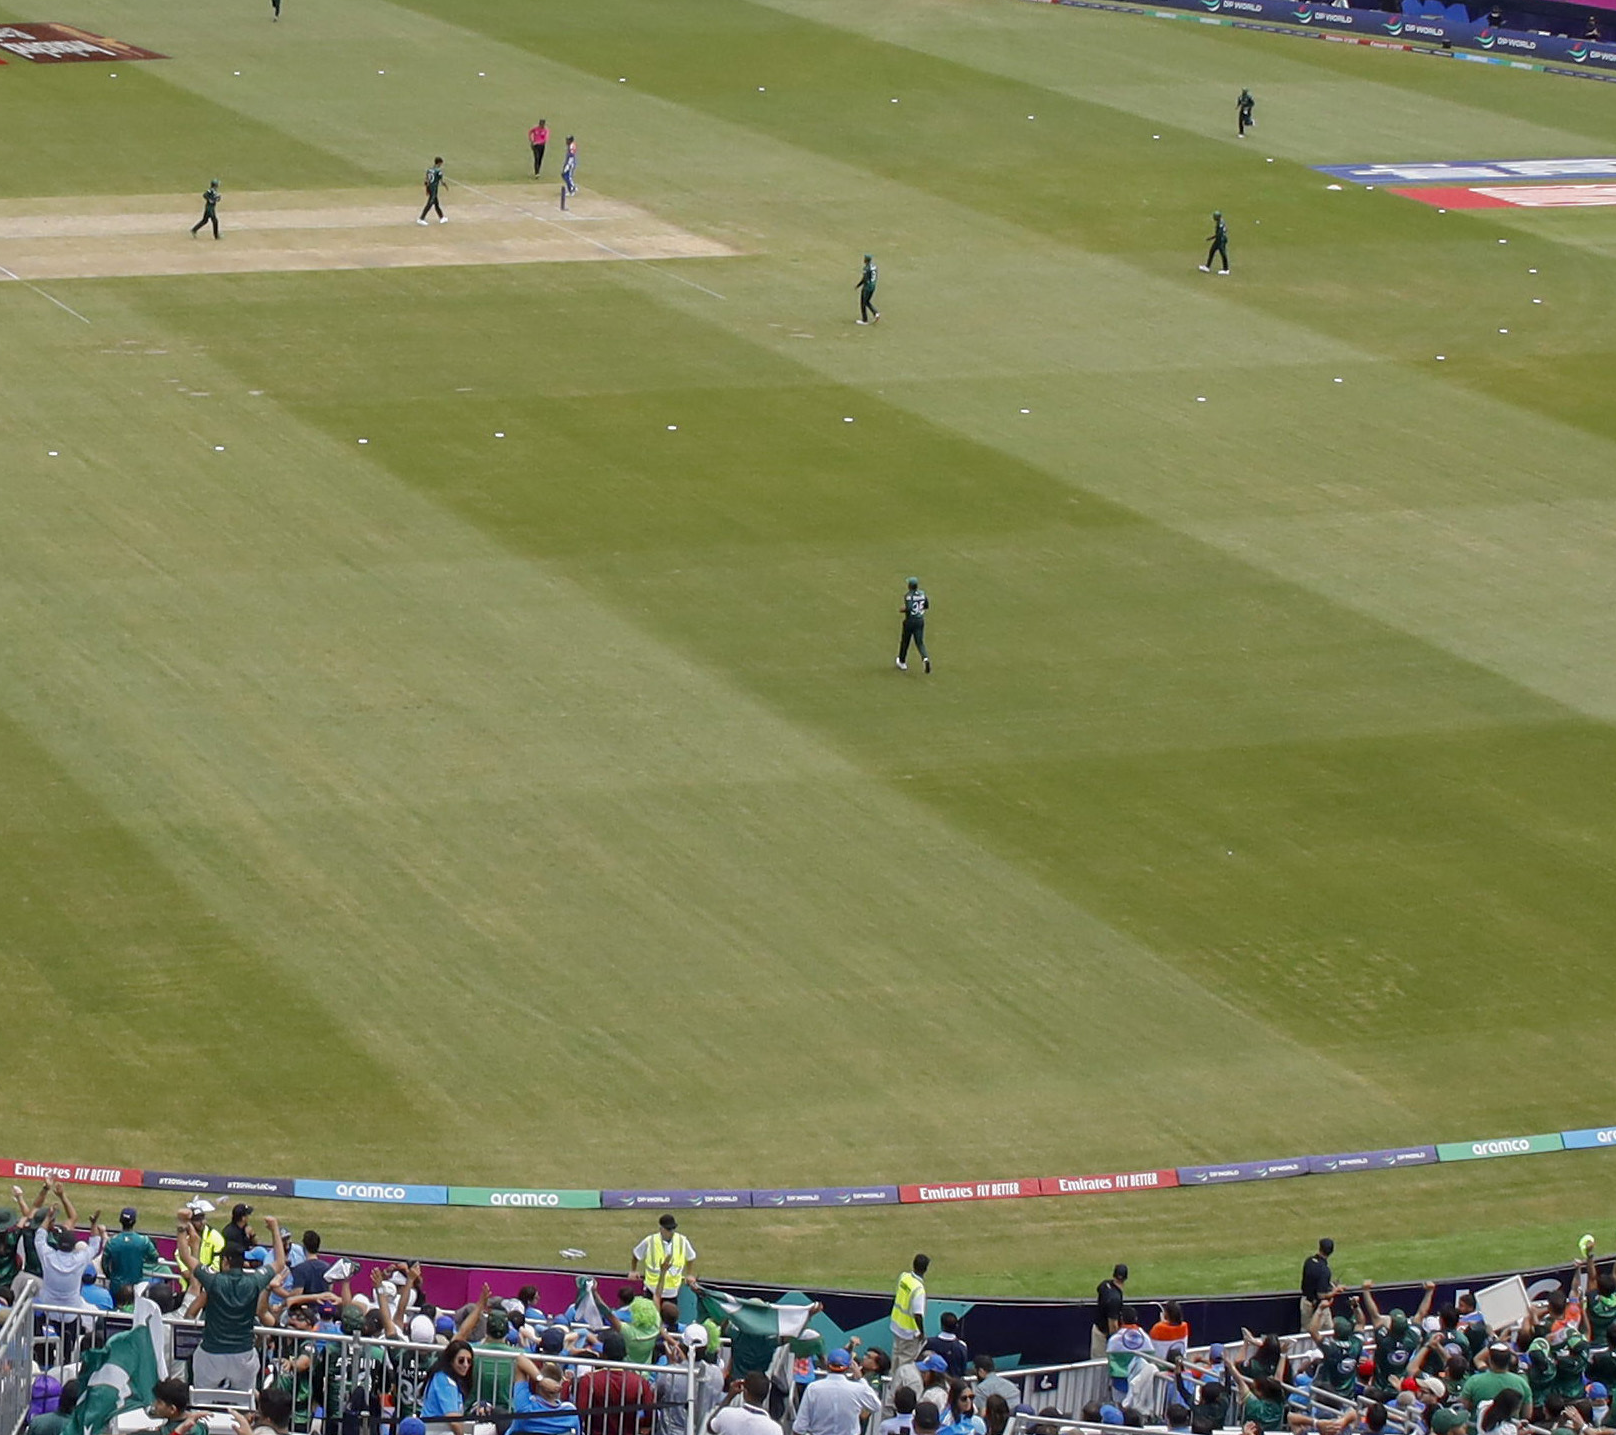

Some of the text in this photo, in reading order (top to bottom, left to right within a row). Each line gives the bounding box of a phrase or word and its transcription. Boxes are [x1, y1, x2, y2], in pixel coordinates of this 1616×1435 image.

[1472, 1138, 1530, 1155] aramco
[14, 1163, 121, 1183] Emirates FLY BETTER
[336, 1184, 405, 1200] aramco
[490, 1191, 559, 1206] aramco
[919, 1182, 1019, 1201] Emirates FLY BETTER
